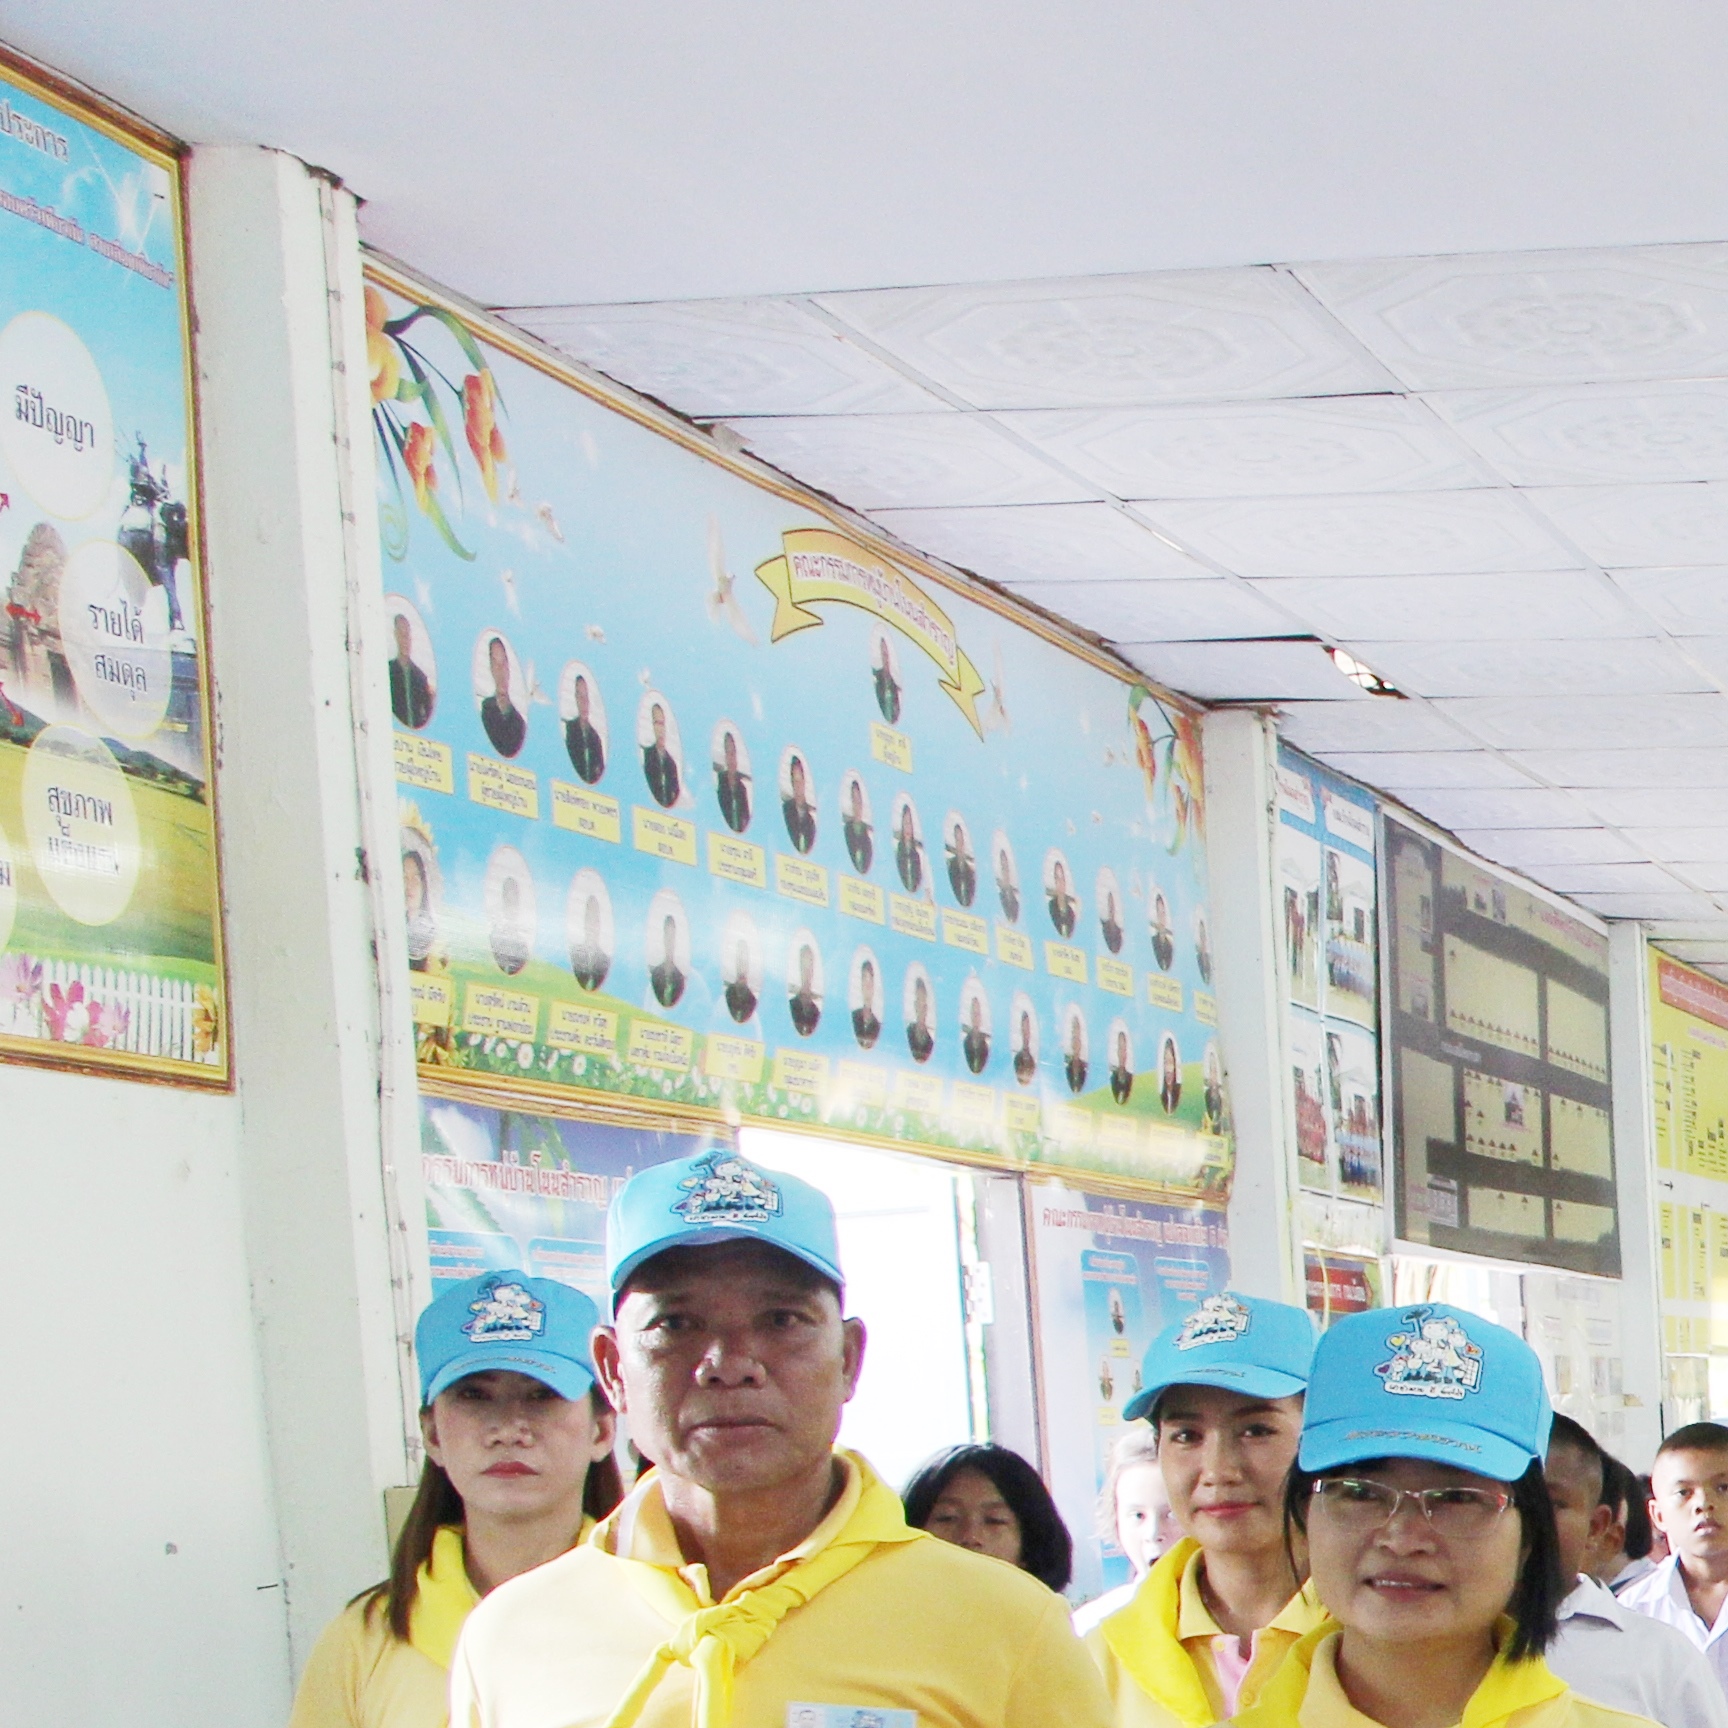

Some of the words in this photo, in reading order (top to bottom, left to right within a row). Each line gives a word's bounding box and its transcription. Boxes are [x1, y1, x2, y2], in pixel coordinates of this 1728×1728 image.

[14, 384, 94, 452] มีปัญญา
[88, 600, 144, 645] รายได้
[94, 653, 147, 702] สมดุล
[47, 786, 113, 828] สุขภาพ
